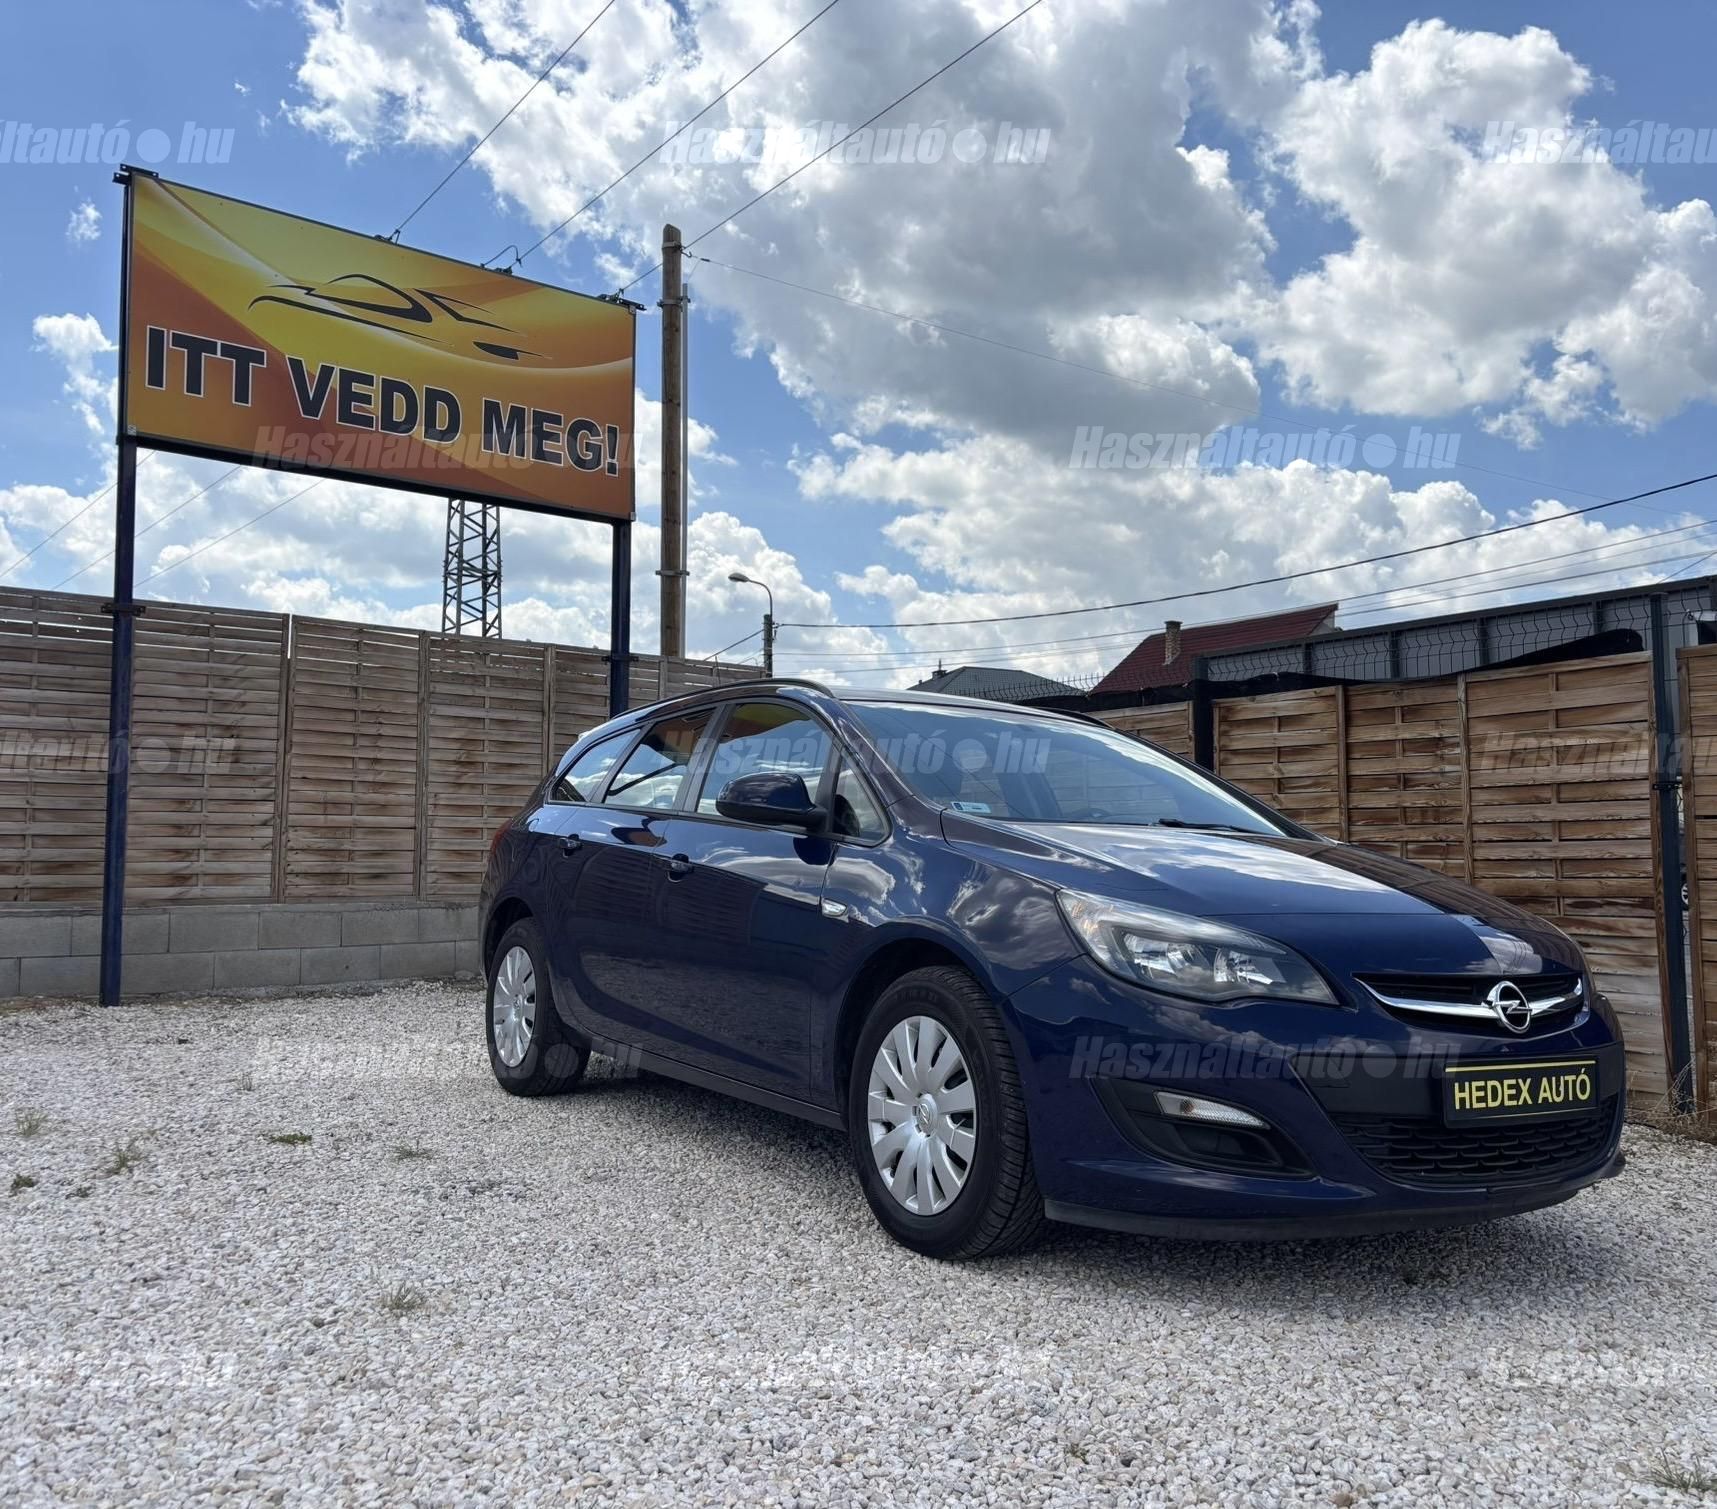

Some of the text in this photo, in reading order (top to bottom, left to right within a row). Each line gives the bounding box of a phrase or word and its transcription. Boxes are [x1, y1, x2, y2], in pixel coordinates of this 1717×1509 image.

[145, 325, 620, 478] ITT VEDD MEG!
[1454, 1067, 1591, 1110] HEDEX AUTÓ
